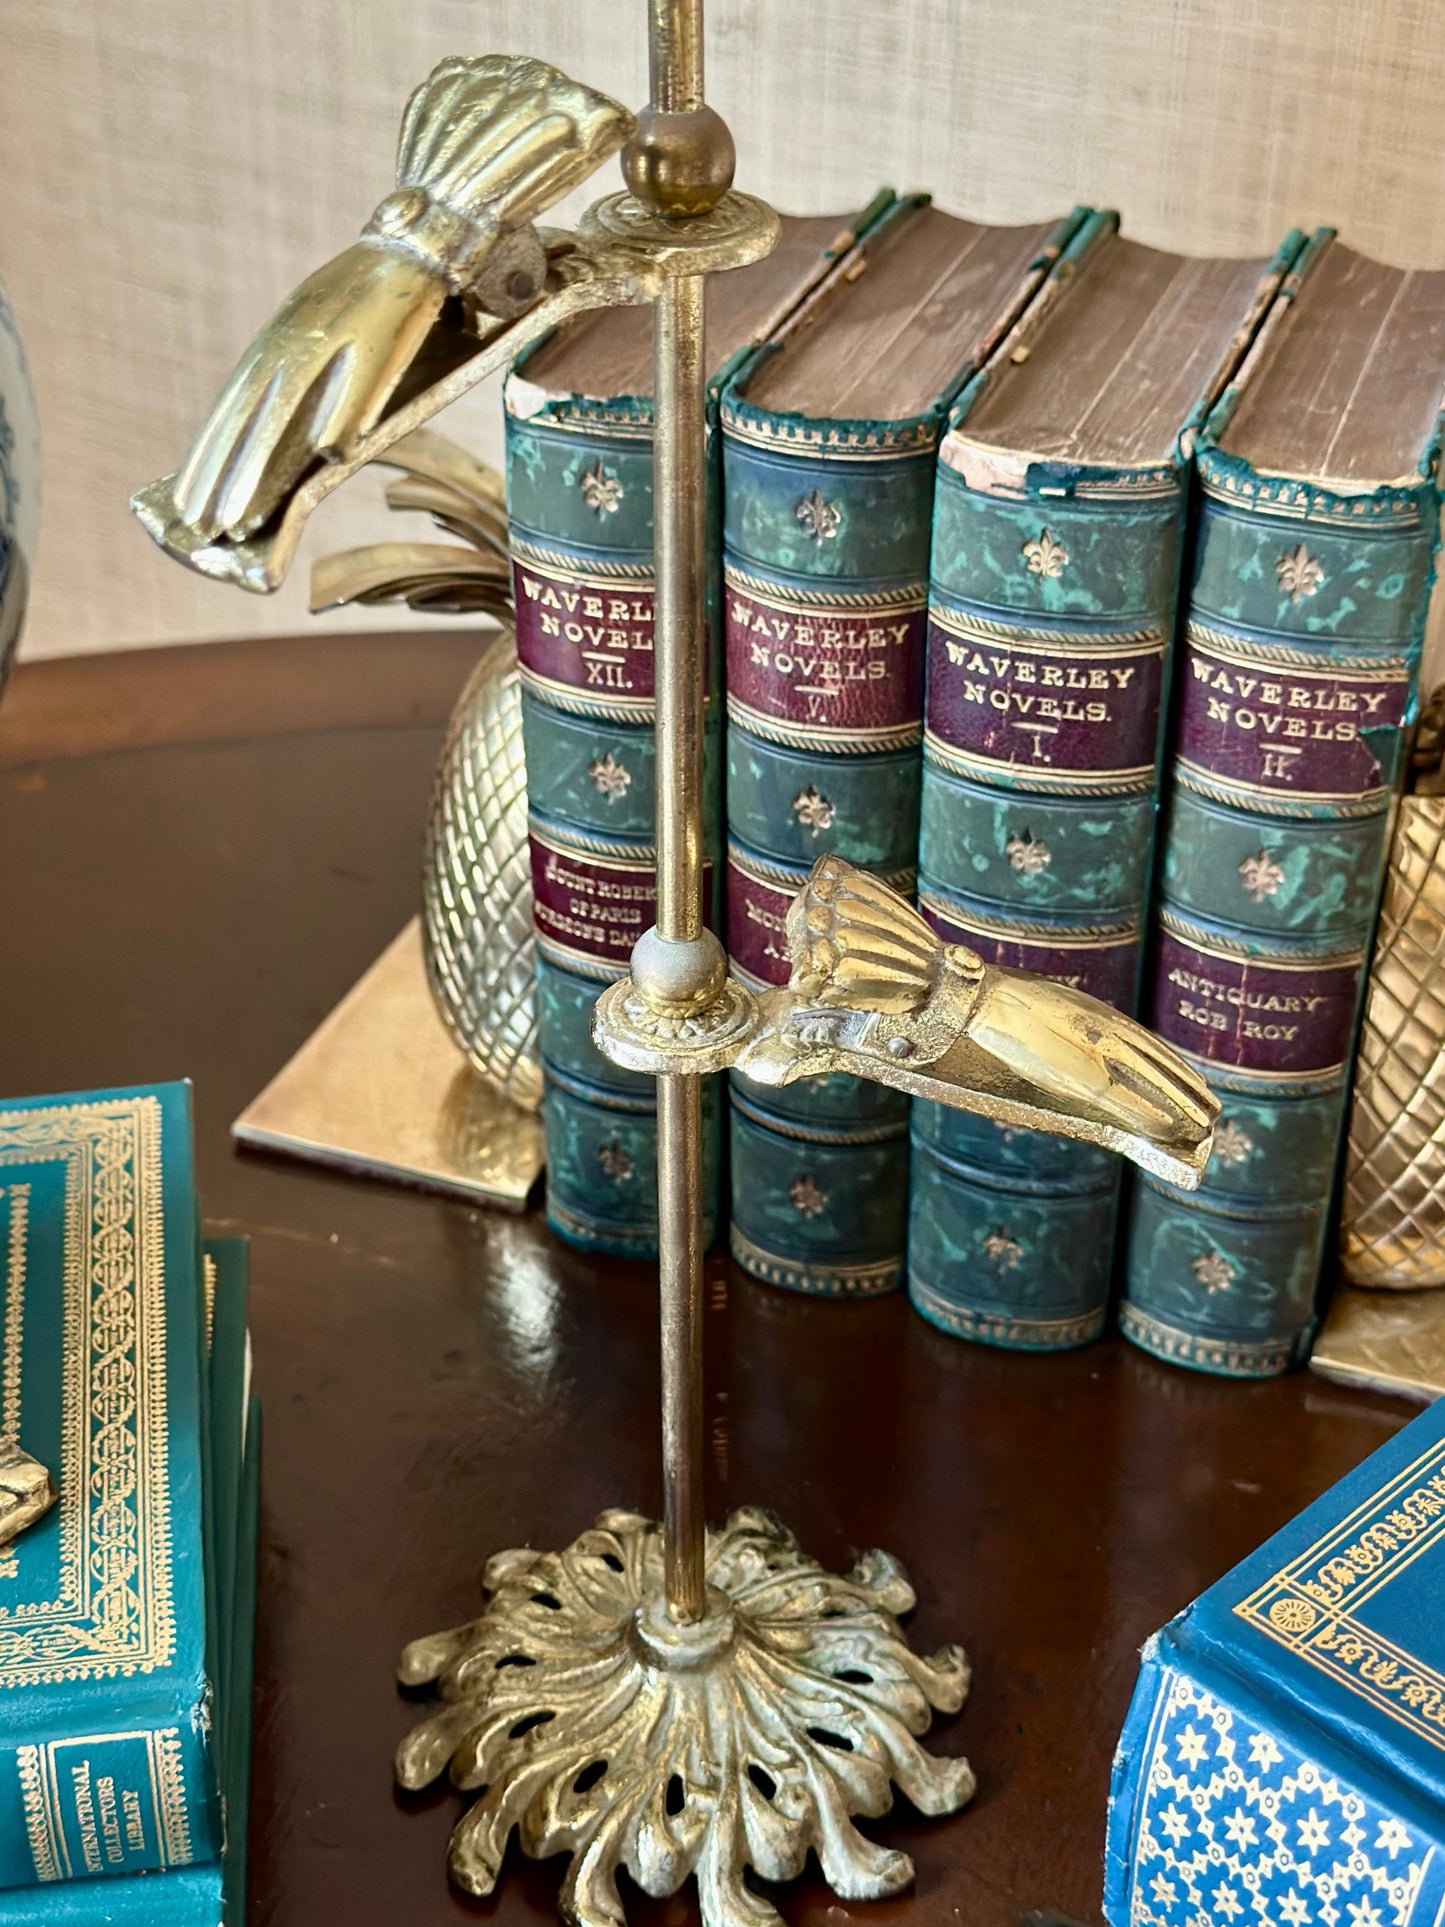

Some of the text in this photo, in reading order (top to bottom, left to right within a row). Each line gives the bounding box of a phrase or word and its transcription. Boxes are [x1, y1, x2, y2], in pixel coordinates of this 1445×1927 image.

[522, 575, 656, 621] WAVERL
[540, 612, 654, 650] NOVEL
[732, 602, 909, 649] WAVERLEY
[585, 662, 633, 689] XII.
[945, 640, 1135, 689] WAVERLEY
[1191, 657, 1387, 713] WAVERLEY
[963, 680, 1112, 722] NOVELS.
[1030, 735, 1051, 763] I.
[1263, 753, 1293, 782] II.
[597, 881, 657, 900] ROBER
[1168, 968, 1328, 1014] ANTIQUARY
[1178, 1000, 1299, 1041] ROB ROY
[96, 1776, 124, 1864] COLLECTORS
[122, 1790, 145, 1851] LIBRARY
